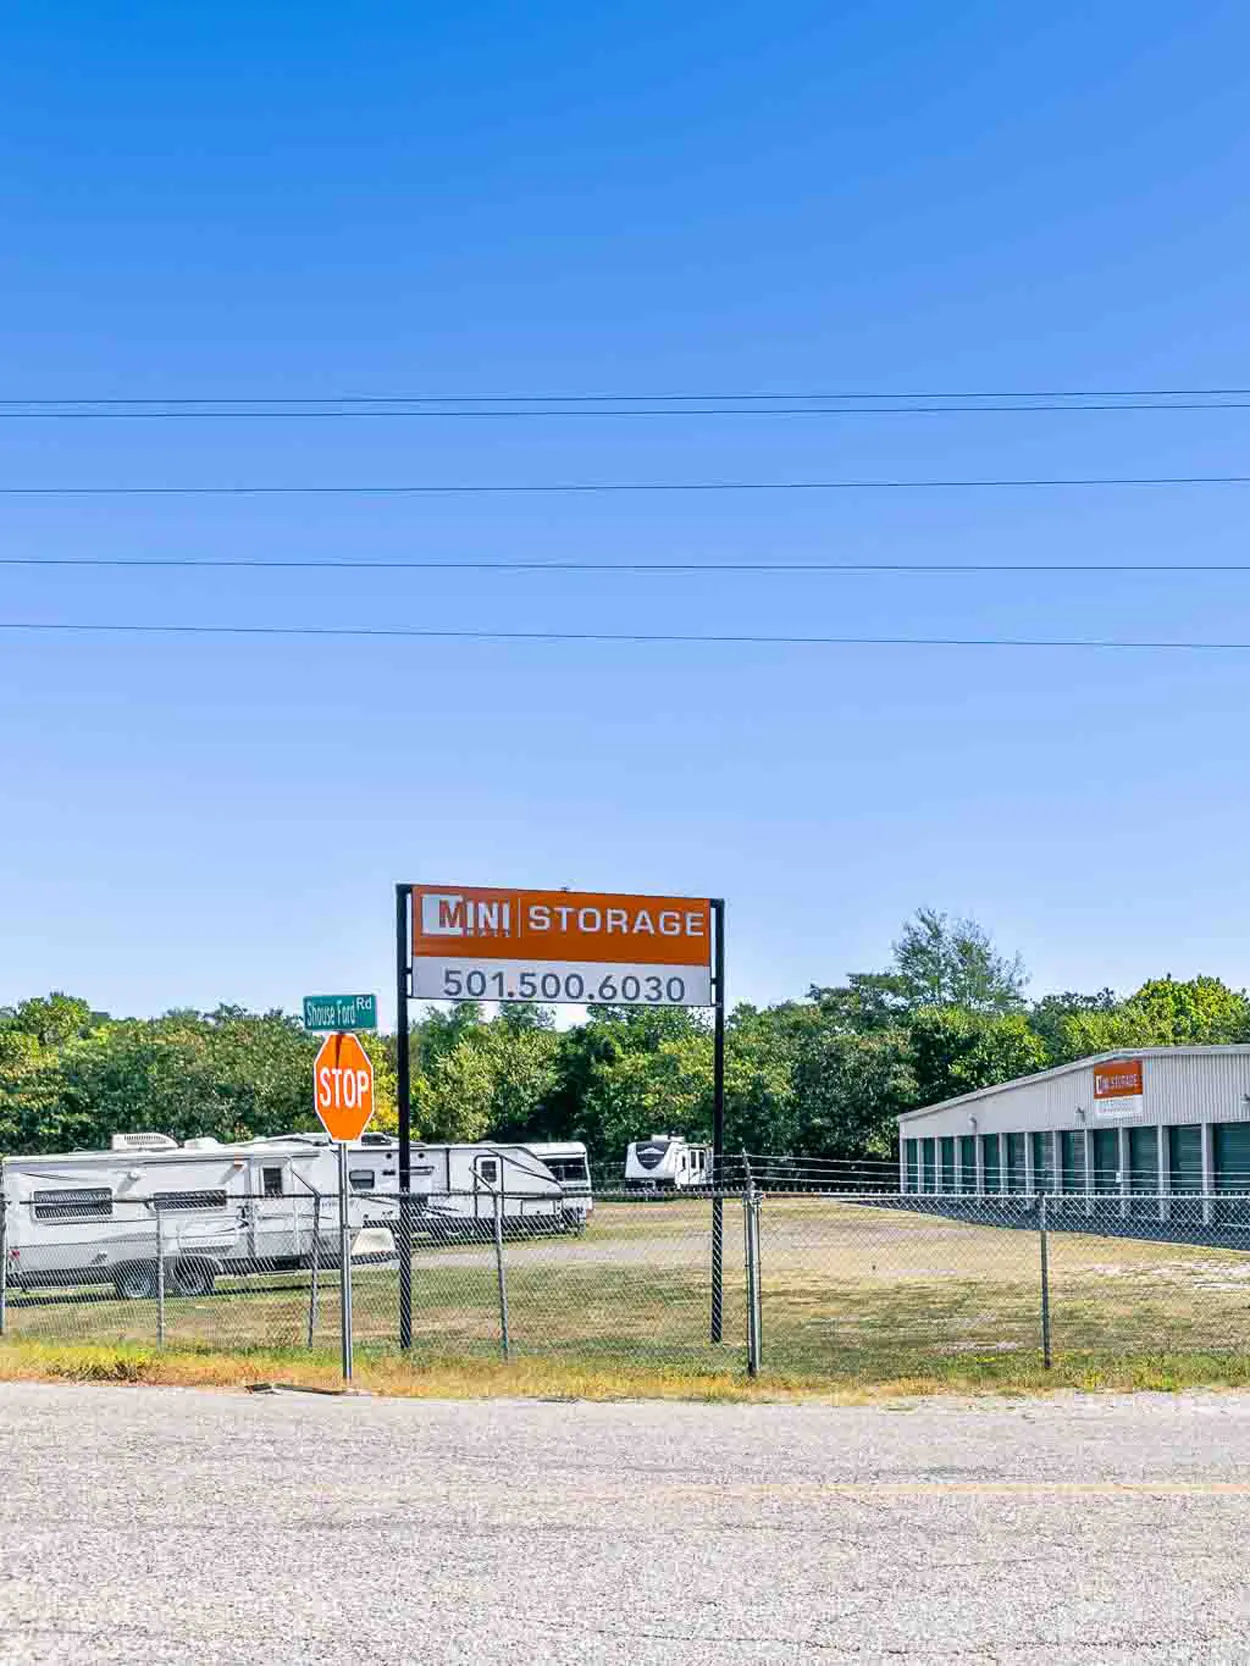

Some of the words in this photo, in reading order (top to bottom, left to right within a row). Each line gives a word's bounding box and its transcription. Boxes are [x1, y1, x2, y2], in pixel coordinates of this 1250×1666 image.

[433, 897, 510, 930] MINI
[528, 905, 704, 937] STORAGE
[442, 969, 686, 1002] 501.500.6030
[306, 1001, 335, 1026] Shouse
[337, 1000, 355, 1025] Ford
[356, 996, 372, 1010] Rd
[319, 1067, 369, 1109] STOP
